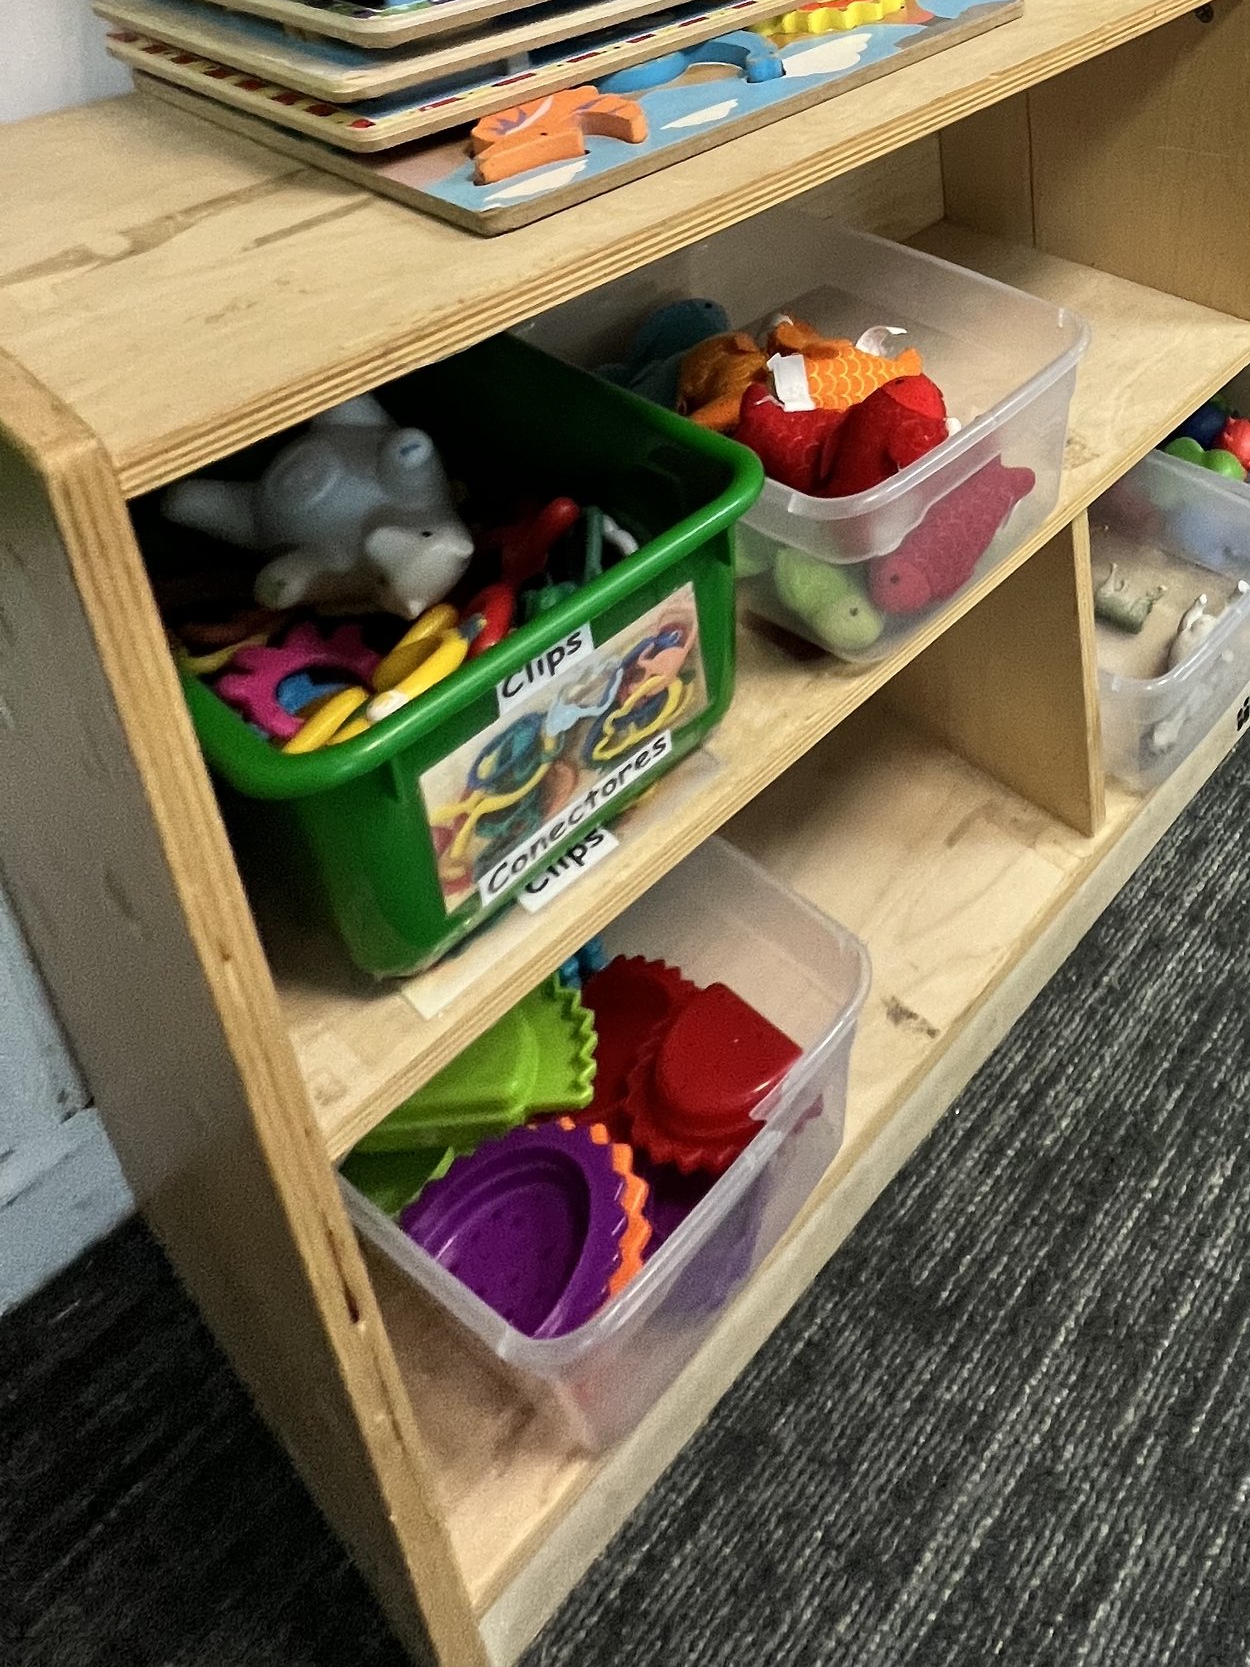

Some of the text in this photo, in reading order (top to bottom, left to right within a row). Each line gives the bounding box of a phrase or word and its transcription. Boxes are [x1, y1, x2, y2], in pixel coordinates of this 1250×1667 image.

[501, 631, 582, 700] Clips
[486, 734, 669, 896] Conectores
[525, 827, 605, 897] Clips
